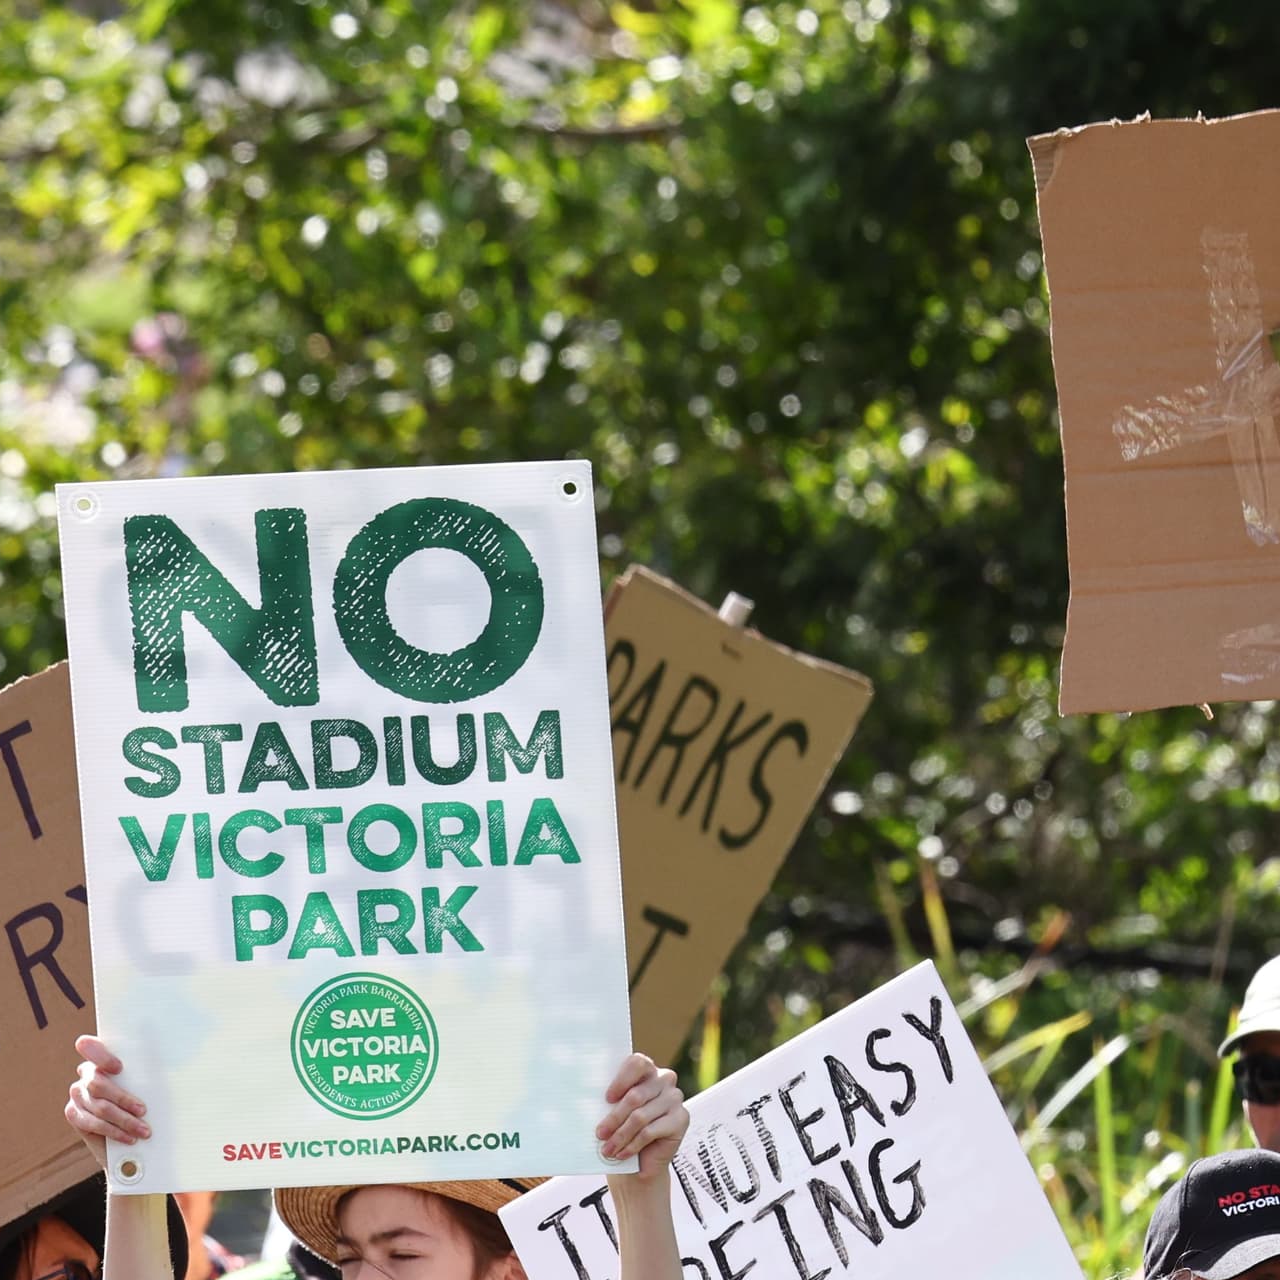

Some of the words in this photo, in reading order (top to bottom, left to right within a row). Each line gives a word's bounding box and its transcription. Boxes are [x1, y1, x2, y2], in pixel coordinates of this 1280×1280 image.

[123, 497, 544, 713] NO
[122, 709, 565, 799] STADIUM
[118, 797, 582, 882] VICTORIA
[231, 884, 485, 962] PARK
[303, 993, 339, 1035] VICTORIA
[339, 984, 369, 998] PARK
[330, 1008, 396, 1029] SAVE
[302, 1034, 428, 1059] VICTORIA
[306, 1062, 357, 1108] RESIDENTS
[359, 1089, 402, 1109] ACTION
[401, 1058, 425, 1093] GROUP
[332, 1063, 402, 1086] PARK
[222, 1131, 521, 1162] SAVEVICTORIAPARK.COM
[1219, 1191, 1246, 1208] NO
